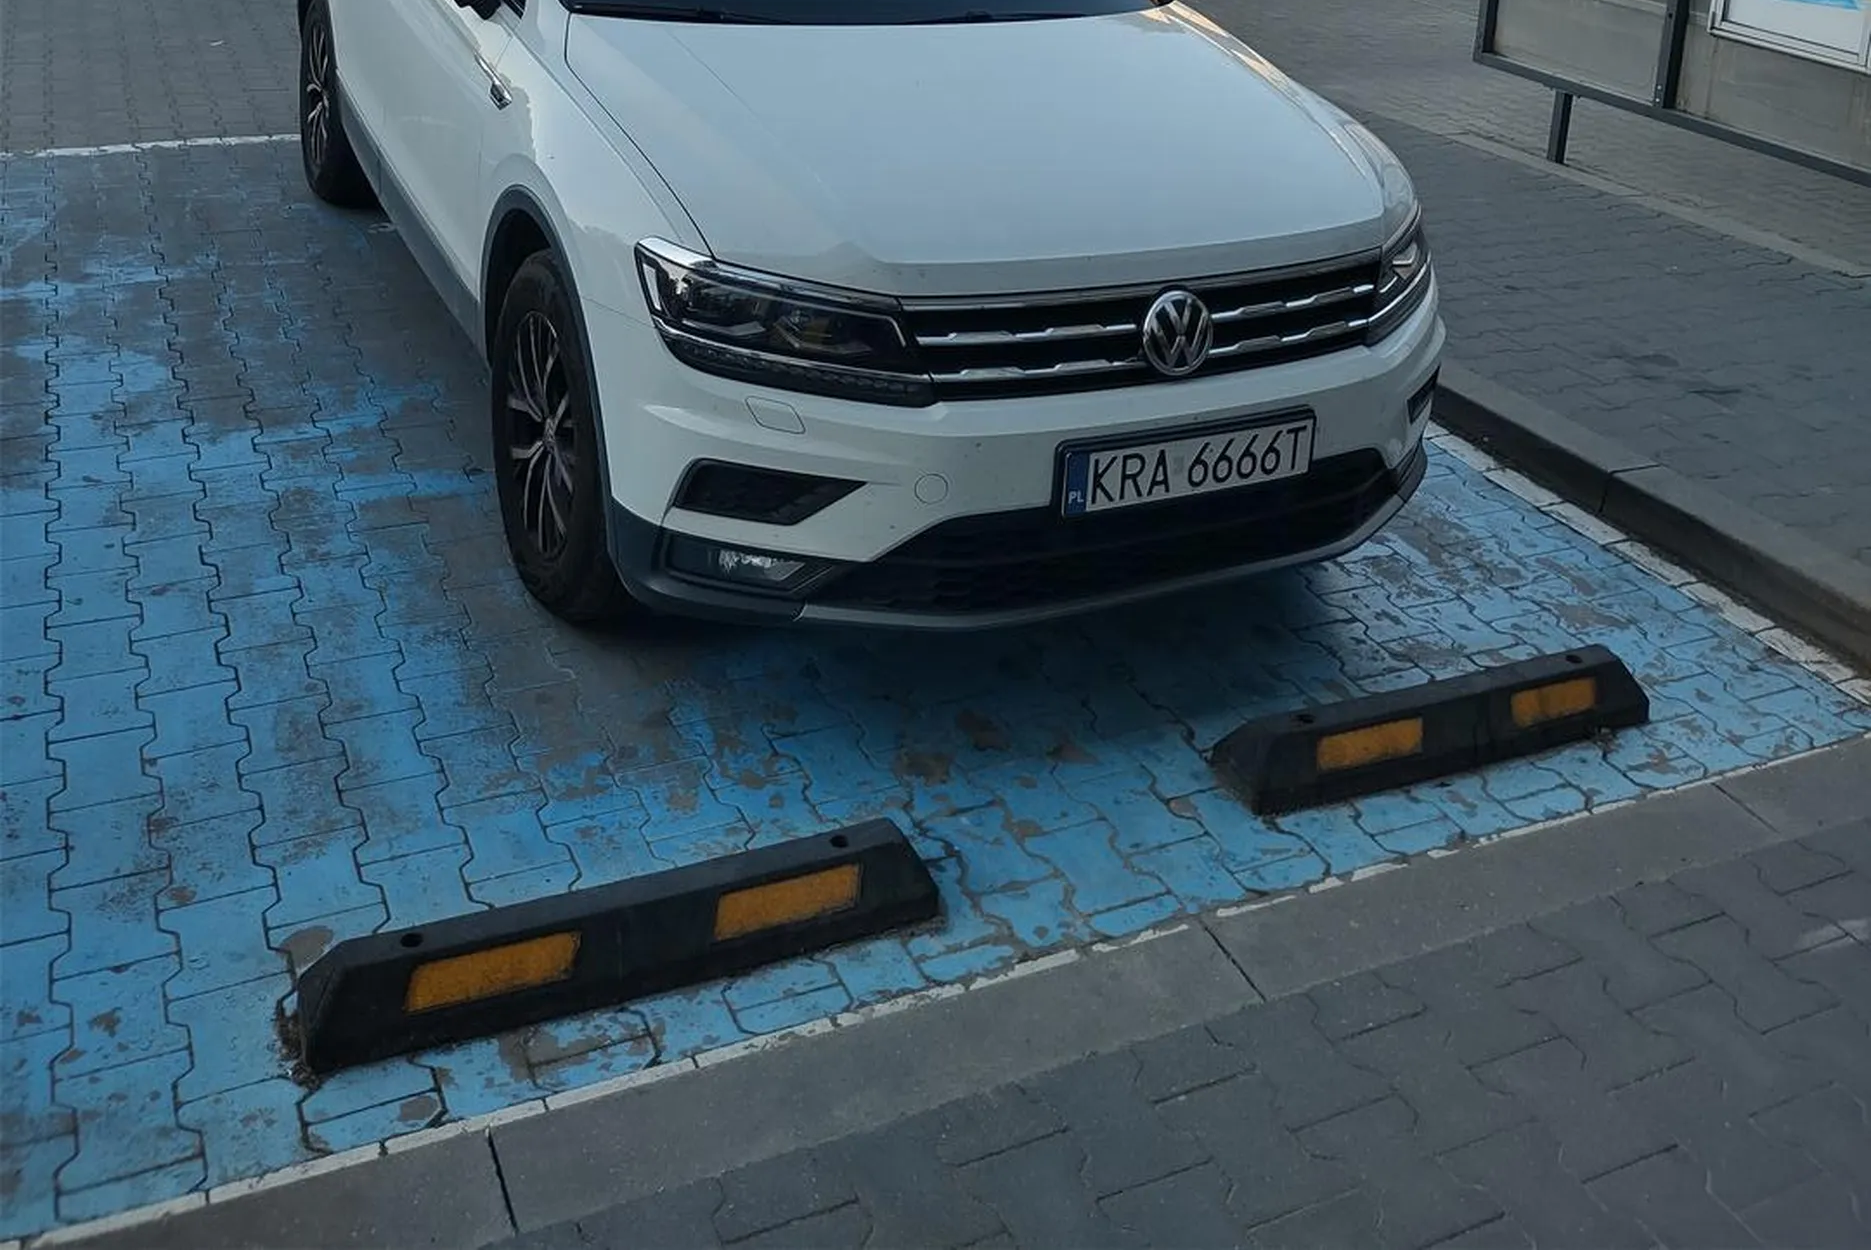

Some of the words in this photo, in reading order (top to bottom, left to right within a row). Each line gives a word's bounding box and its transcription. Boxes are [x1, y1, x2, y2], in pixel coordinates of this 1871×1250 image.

[1090, 449, 1171, 505] KRA
[1187, 425, 1308, 488] 6666T
[1068, 490, 1085, 504] PL
